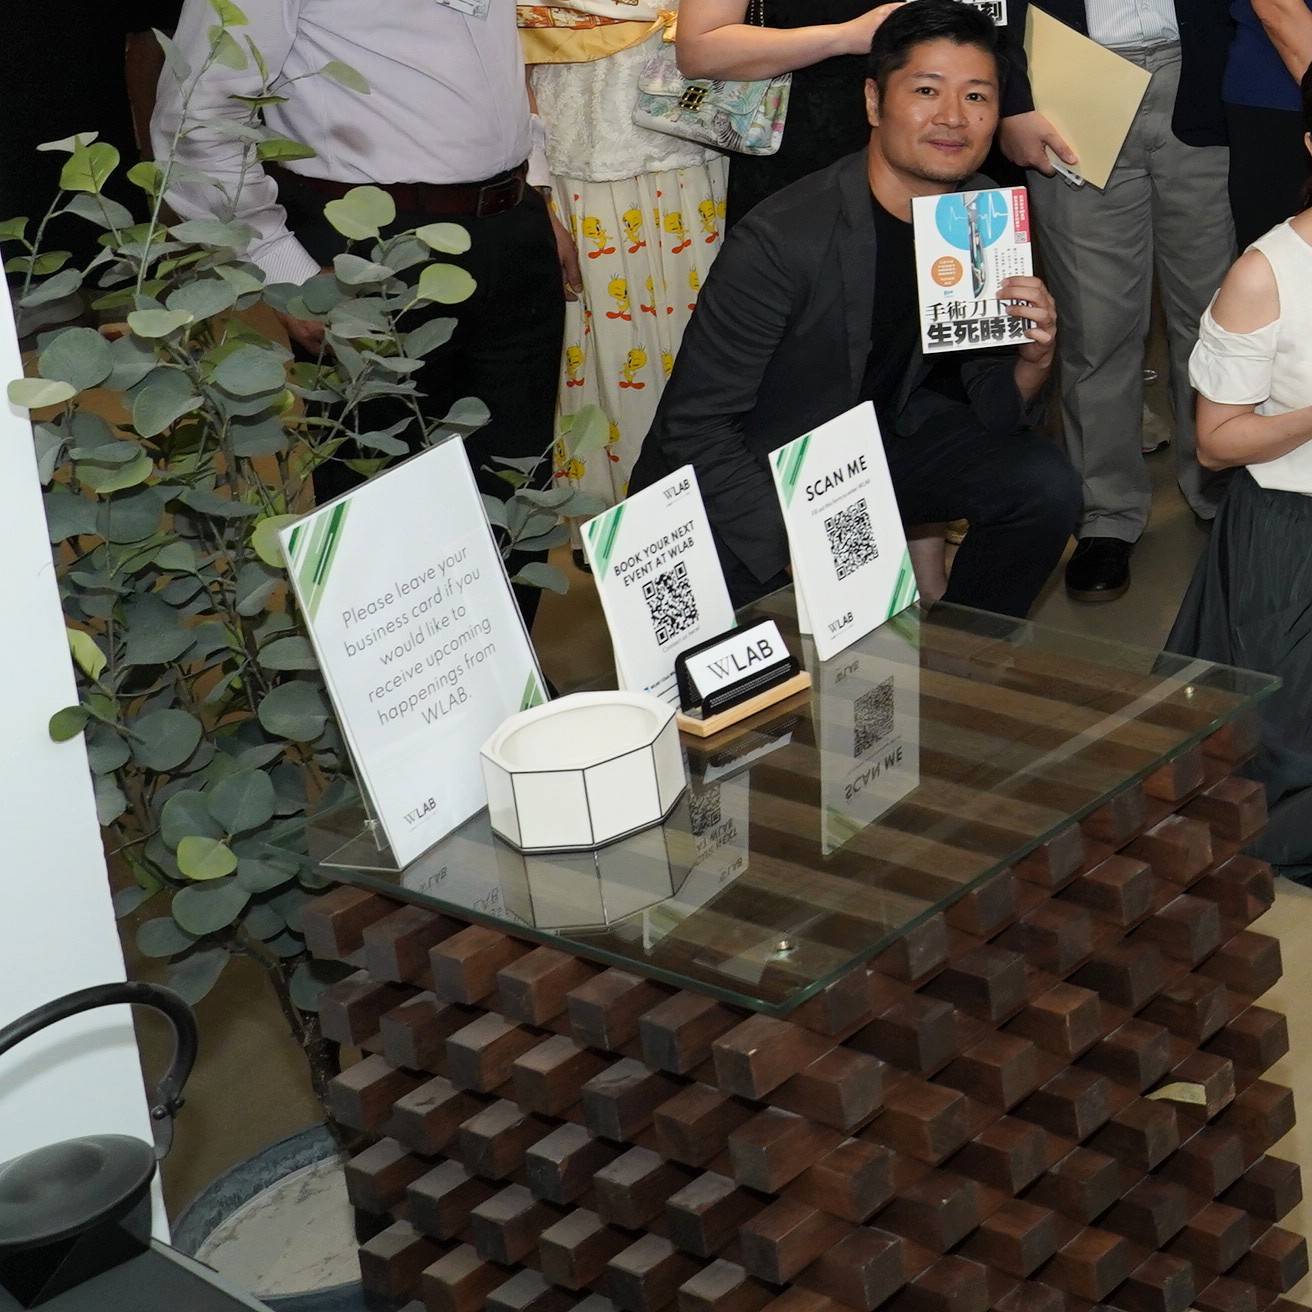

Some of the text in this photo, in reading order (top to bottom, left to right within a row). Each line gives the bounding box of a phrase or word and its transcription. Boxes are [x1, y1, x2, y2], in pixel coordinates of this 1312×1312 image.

[926, 316, 1032, 349] 生死時刻
[805, 467, 845, 502] SCAN
[848, 454, 868, 478] ME
[614, 520, 695, 577] BOOK YOUR NEXT
[623, 537, 695, 587] EVENT AT WLAB
[342, 546, 468, 629] Please leave your
[344, 568, 481, 657] business card if you
[368, 617, 493, 703] receive upcoming
[380, 604, 466, 665] would like to
[707, 639, 774, 680] WLAB
[377, 642, 497, 726] happenings from
[420, 686, 472, 725] WLAB.
